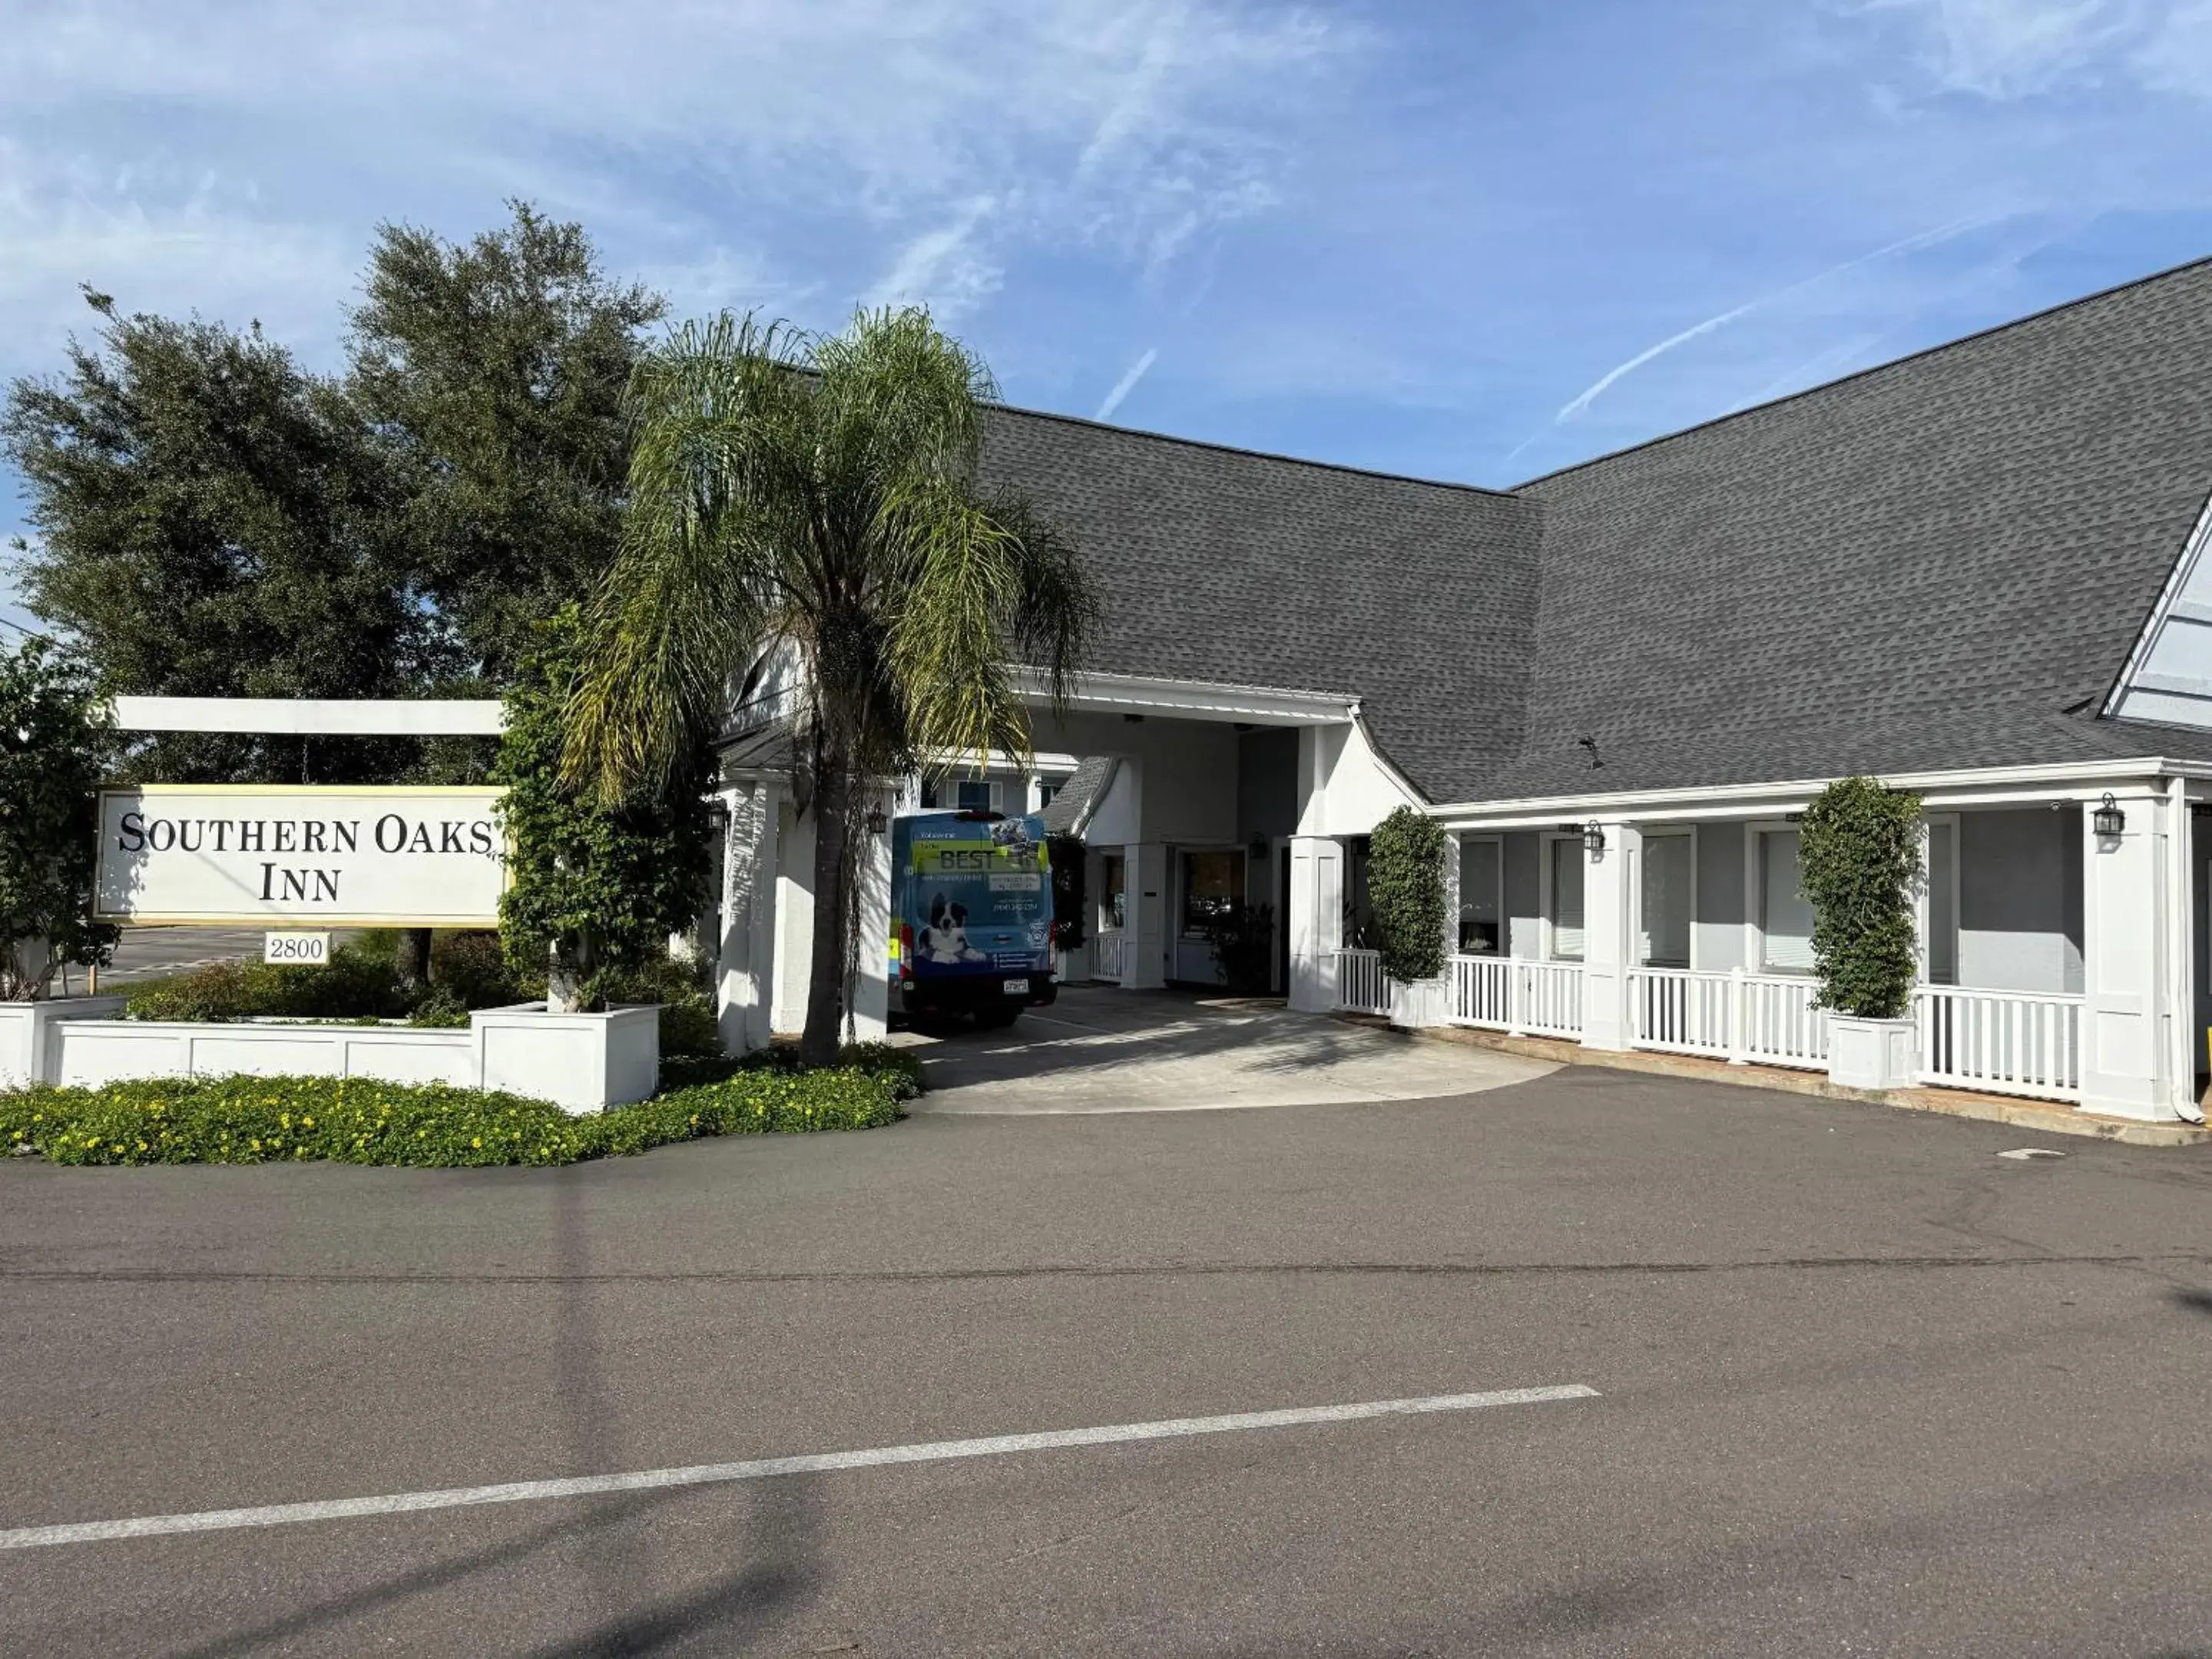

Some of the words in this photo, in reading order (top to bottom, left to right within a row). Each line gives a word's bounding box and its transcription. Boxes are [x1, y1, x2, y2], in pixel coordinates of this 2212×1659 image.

[118, 812, 359, 853] SOUTHERN
[375, 813, 493, 854] OAKS
[939, 849, 995, 869] BEST
[258, 863, 342, 902] INN
[270, 939, 323, 959] 2800
